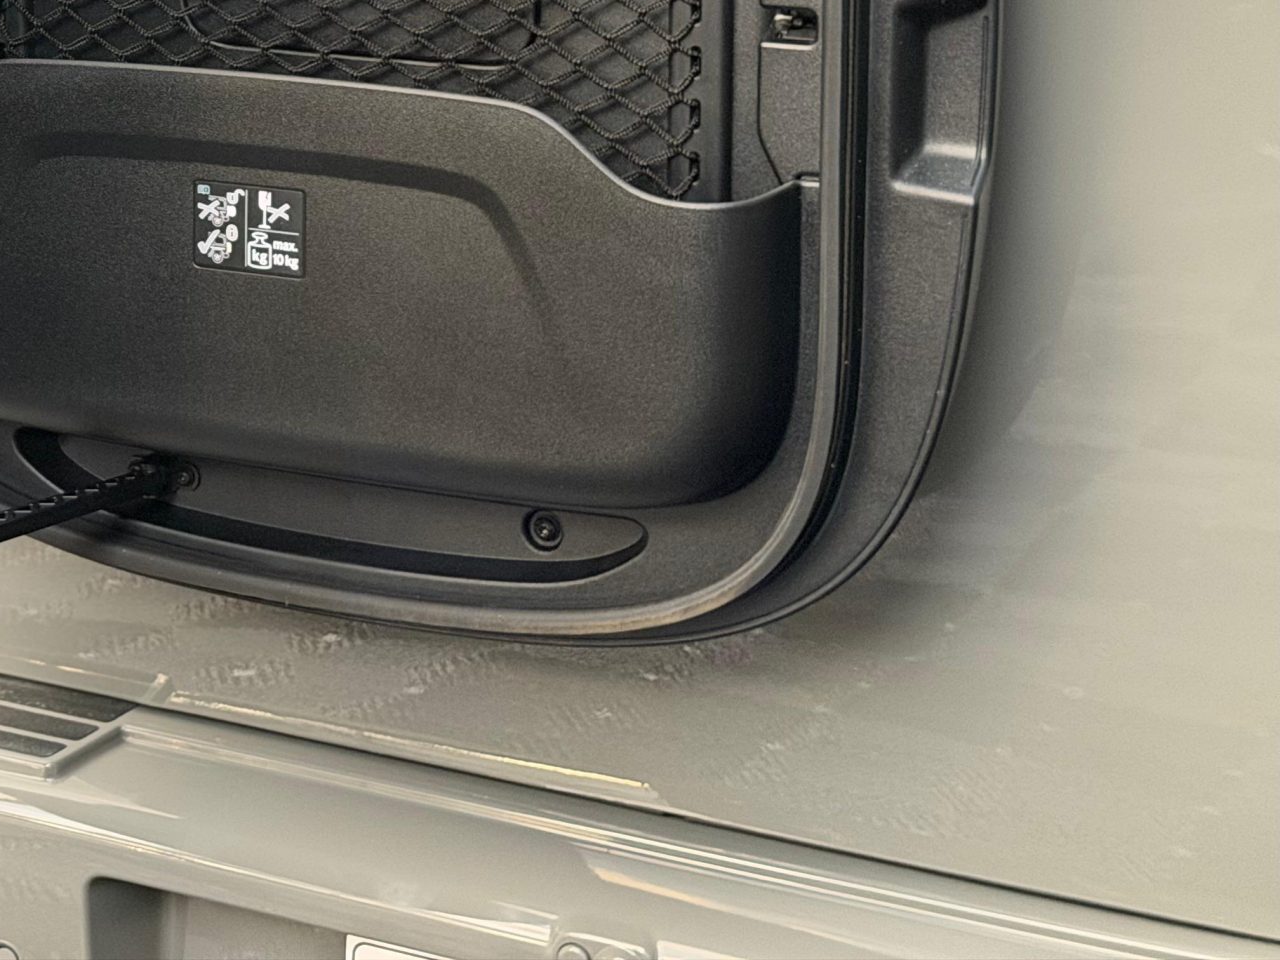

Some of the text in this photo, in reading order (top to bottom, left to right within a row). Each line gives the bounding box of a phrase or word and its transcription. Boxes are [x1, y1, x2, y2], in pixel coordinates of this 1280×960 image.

[273, 240, 299, 252] max.
[252, 249, 268, 265] kg
[273, 254, 299, 270] 10 kg
